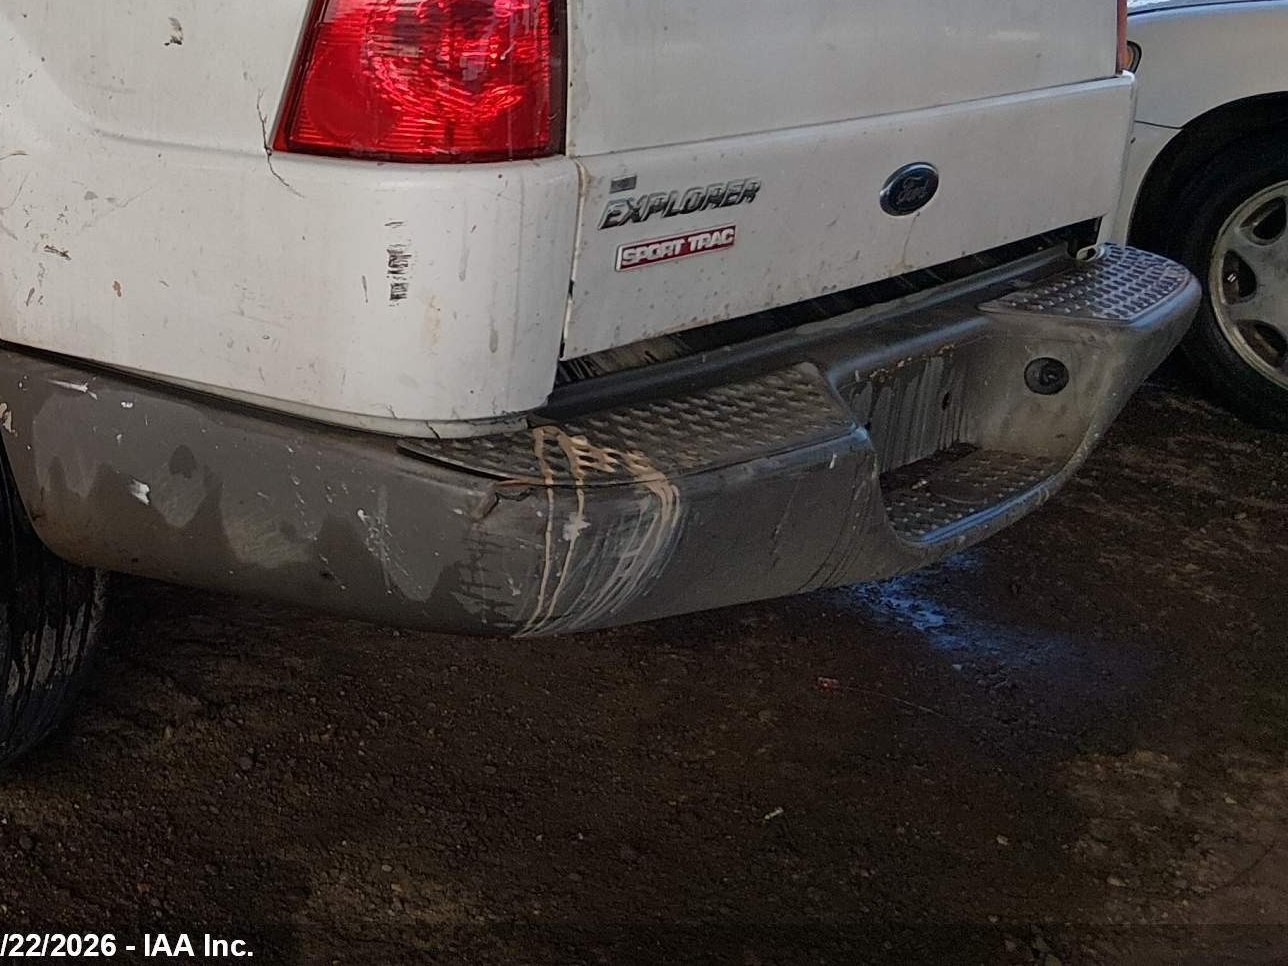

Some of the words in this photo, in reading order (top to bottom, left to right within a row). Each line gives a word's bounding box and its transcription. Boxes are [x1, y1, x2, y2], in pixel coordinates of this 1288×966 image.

[599, 177, 762, 230] EXPLORER
[621, 239, 686, 266] SPORT
[687, 227, 735, 252] TRAC
